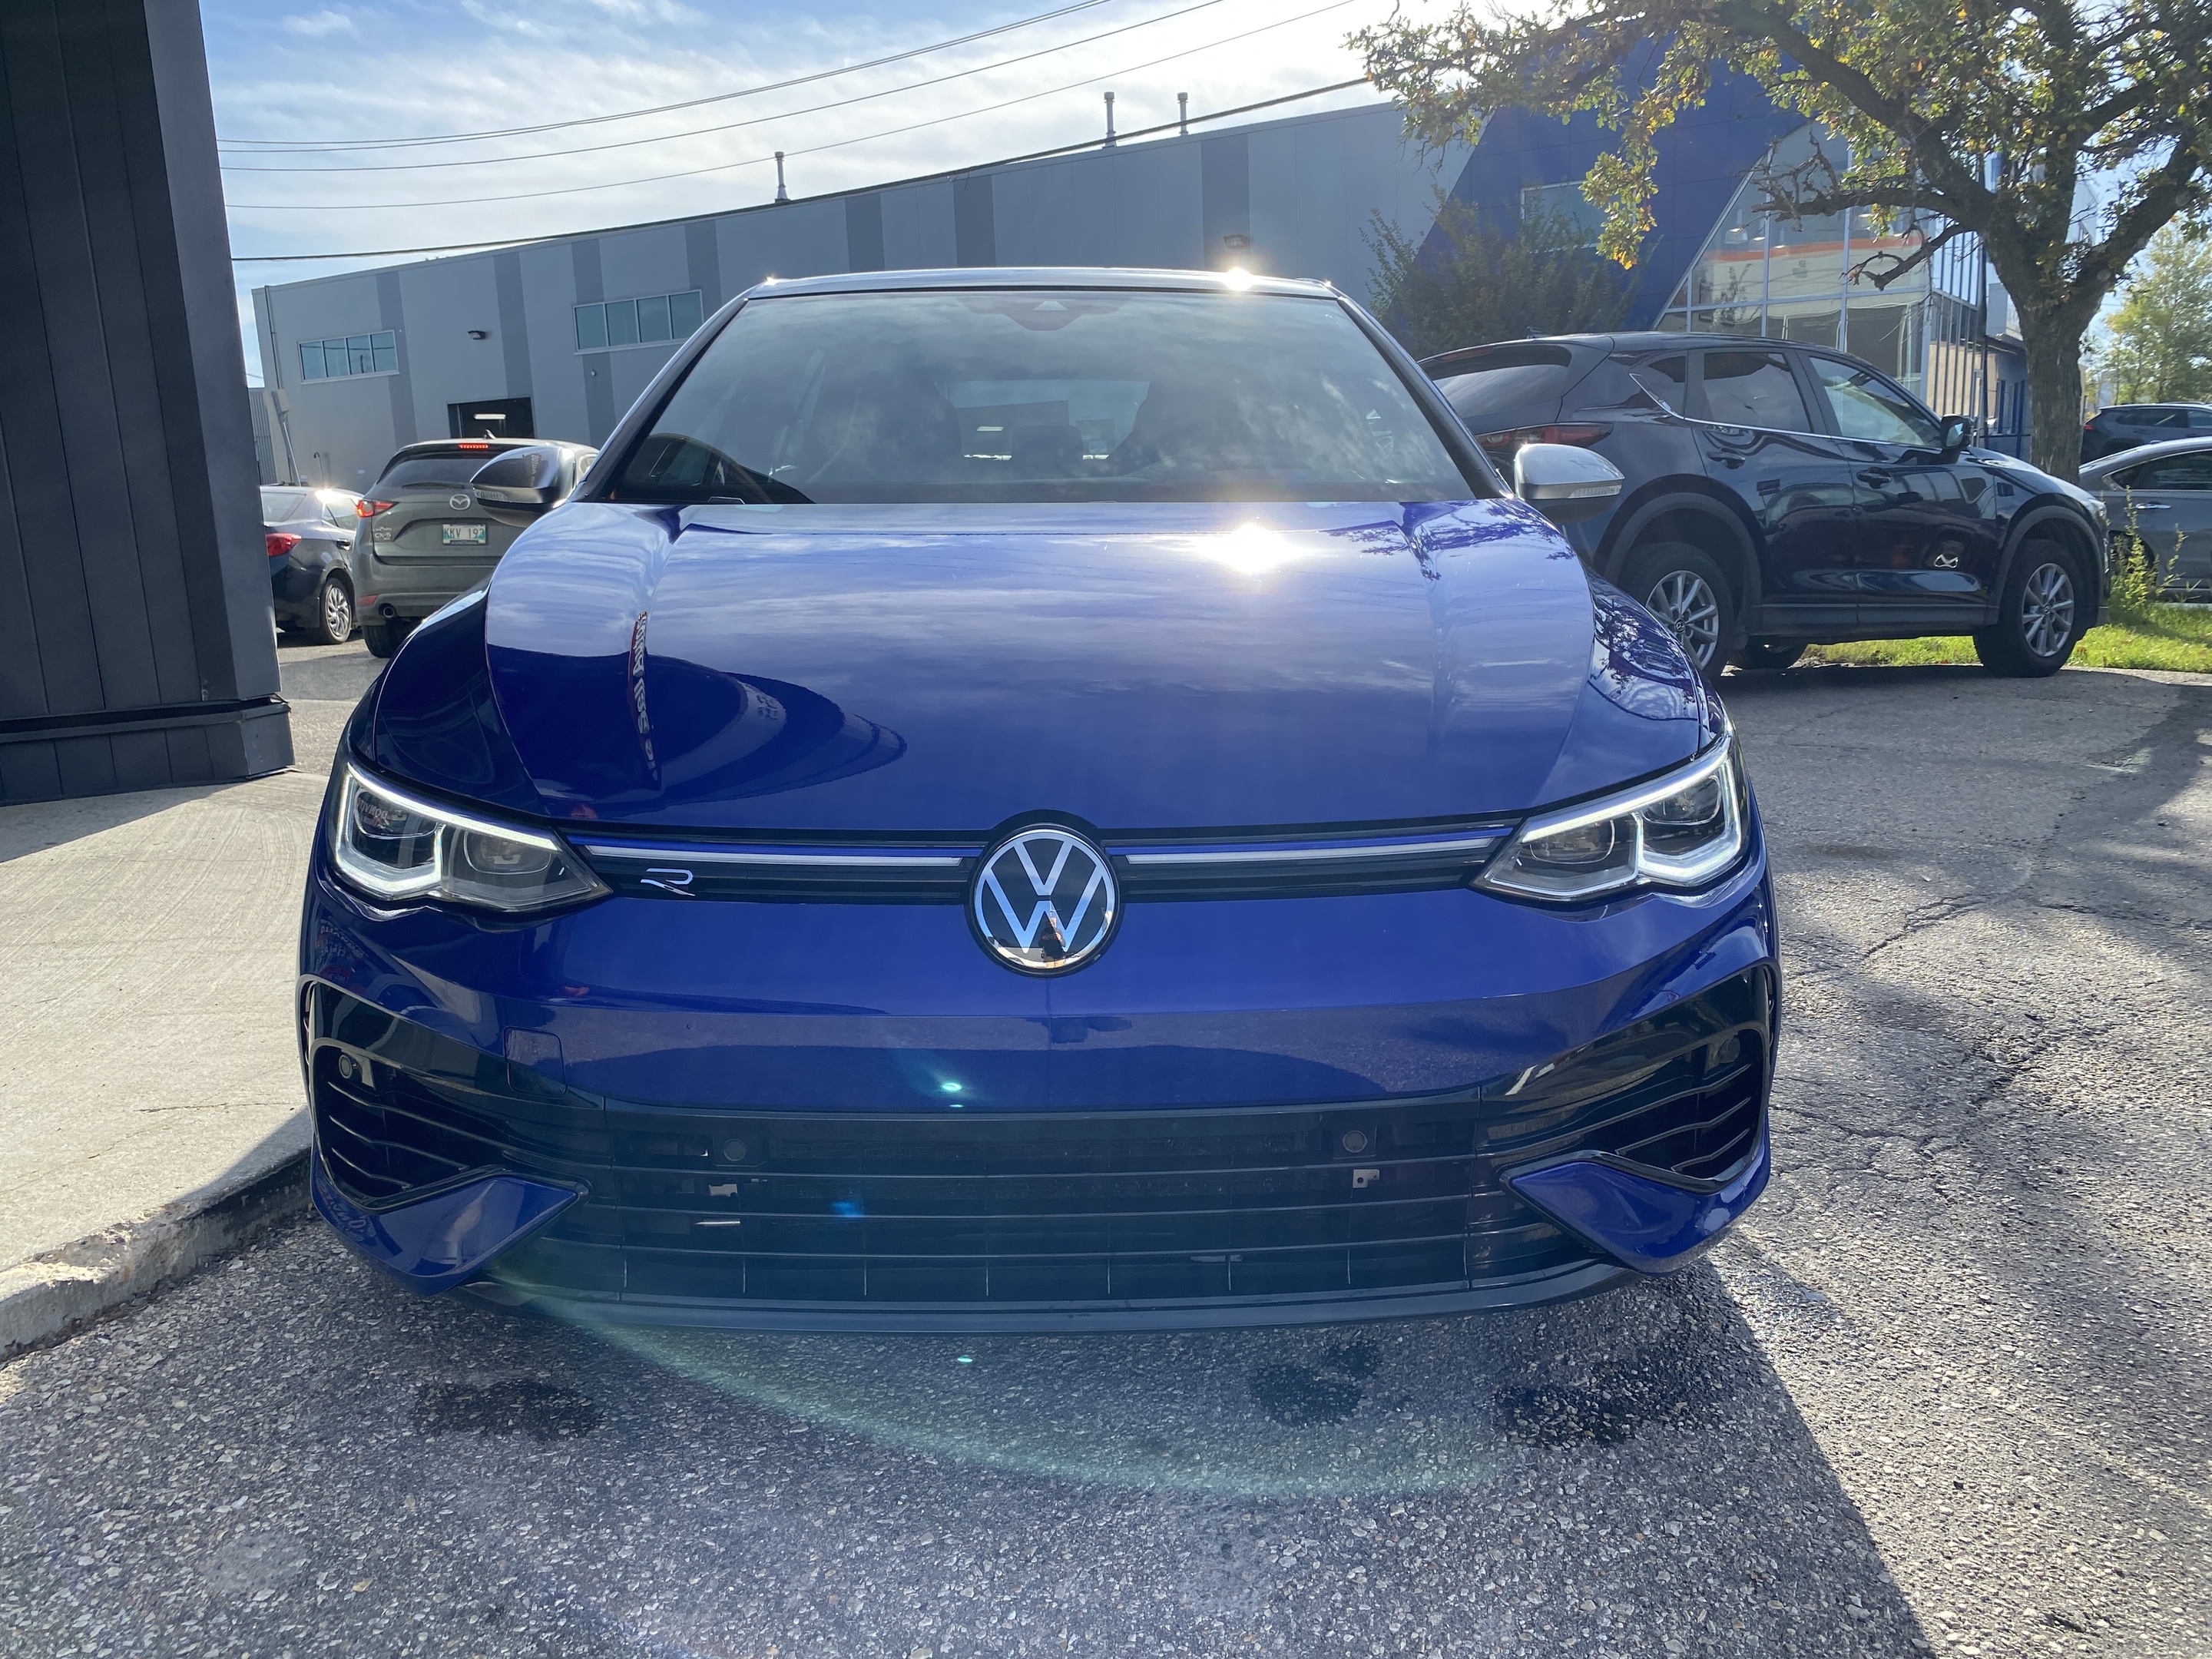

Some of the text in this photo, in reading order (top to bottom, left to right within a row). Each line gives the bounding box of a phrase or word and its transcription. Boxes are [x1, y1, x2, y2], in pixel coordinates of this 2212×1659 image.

[444, 528, 462, 539] KKV
[640, 867, 696, 897] R
[980, 834, 1109, 960] VW
